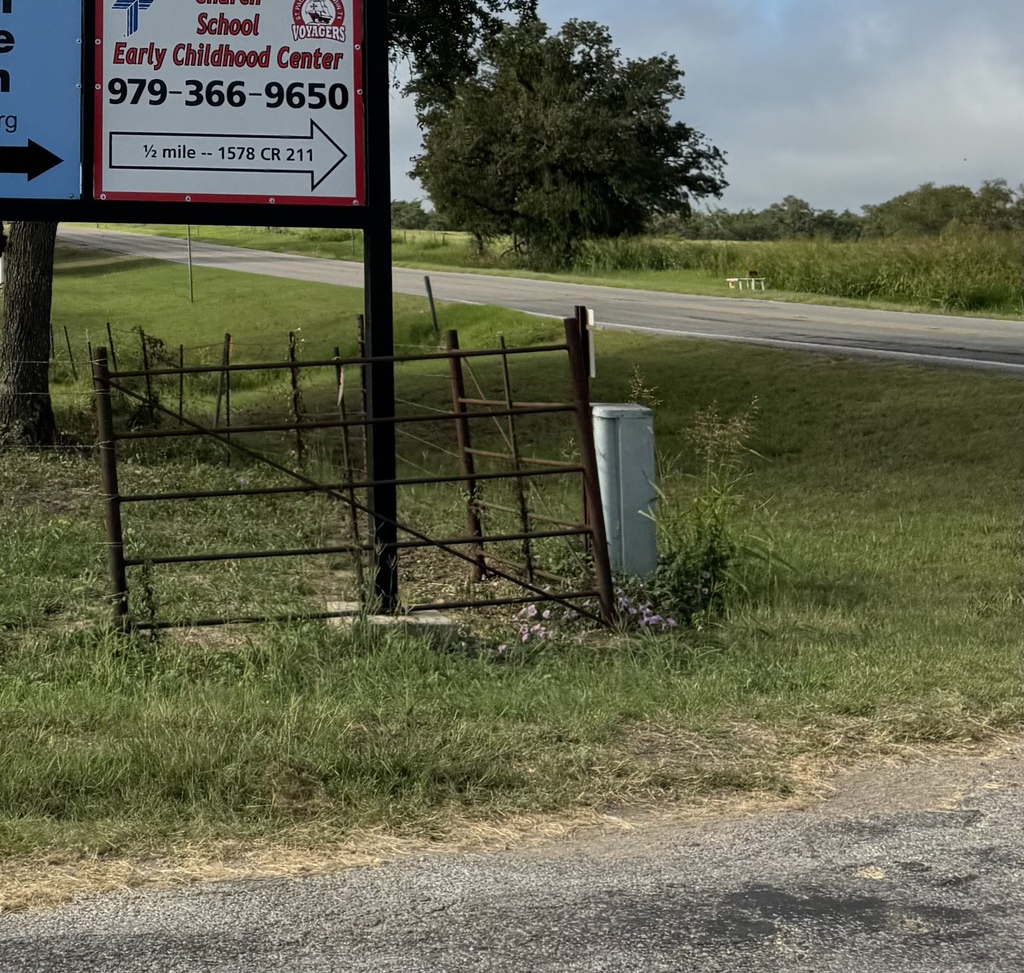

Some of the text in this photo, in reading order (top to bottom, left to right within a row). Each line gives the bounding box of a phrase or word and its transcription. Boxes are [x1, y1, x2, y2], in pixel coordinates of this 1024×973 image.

[196, 12, 260, 36] School
[291, 24, 346, 42] VOYAGERS
[113, 42, 343, 70] Early Childhood Center
[108, 78, 349, 110] 979-366-9650
[162, 145, 196, 159] mile
[218, 146, 256, 160] 1578
[260, 147, 281, 161] CR
[286, 148, 314, 162] 211
